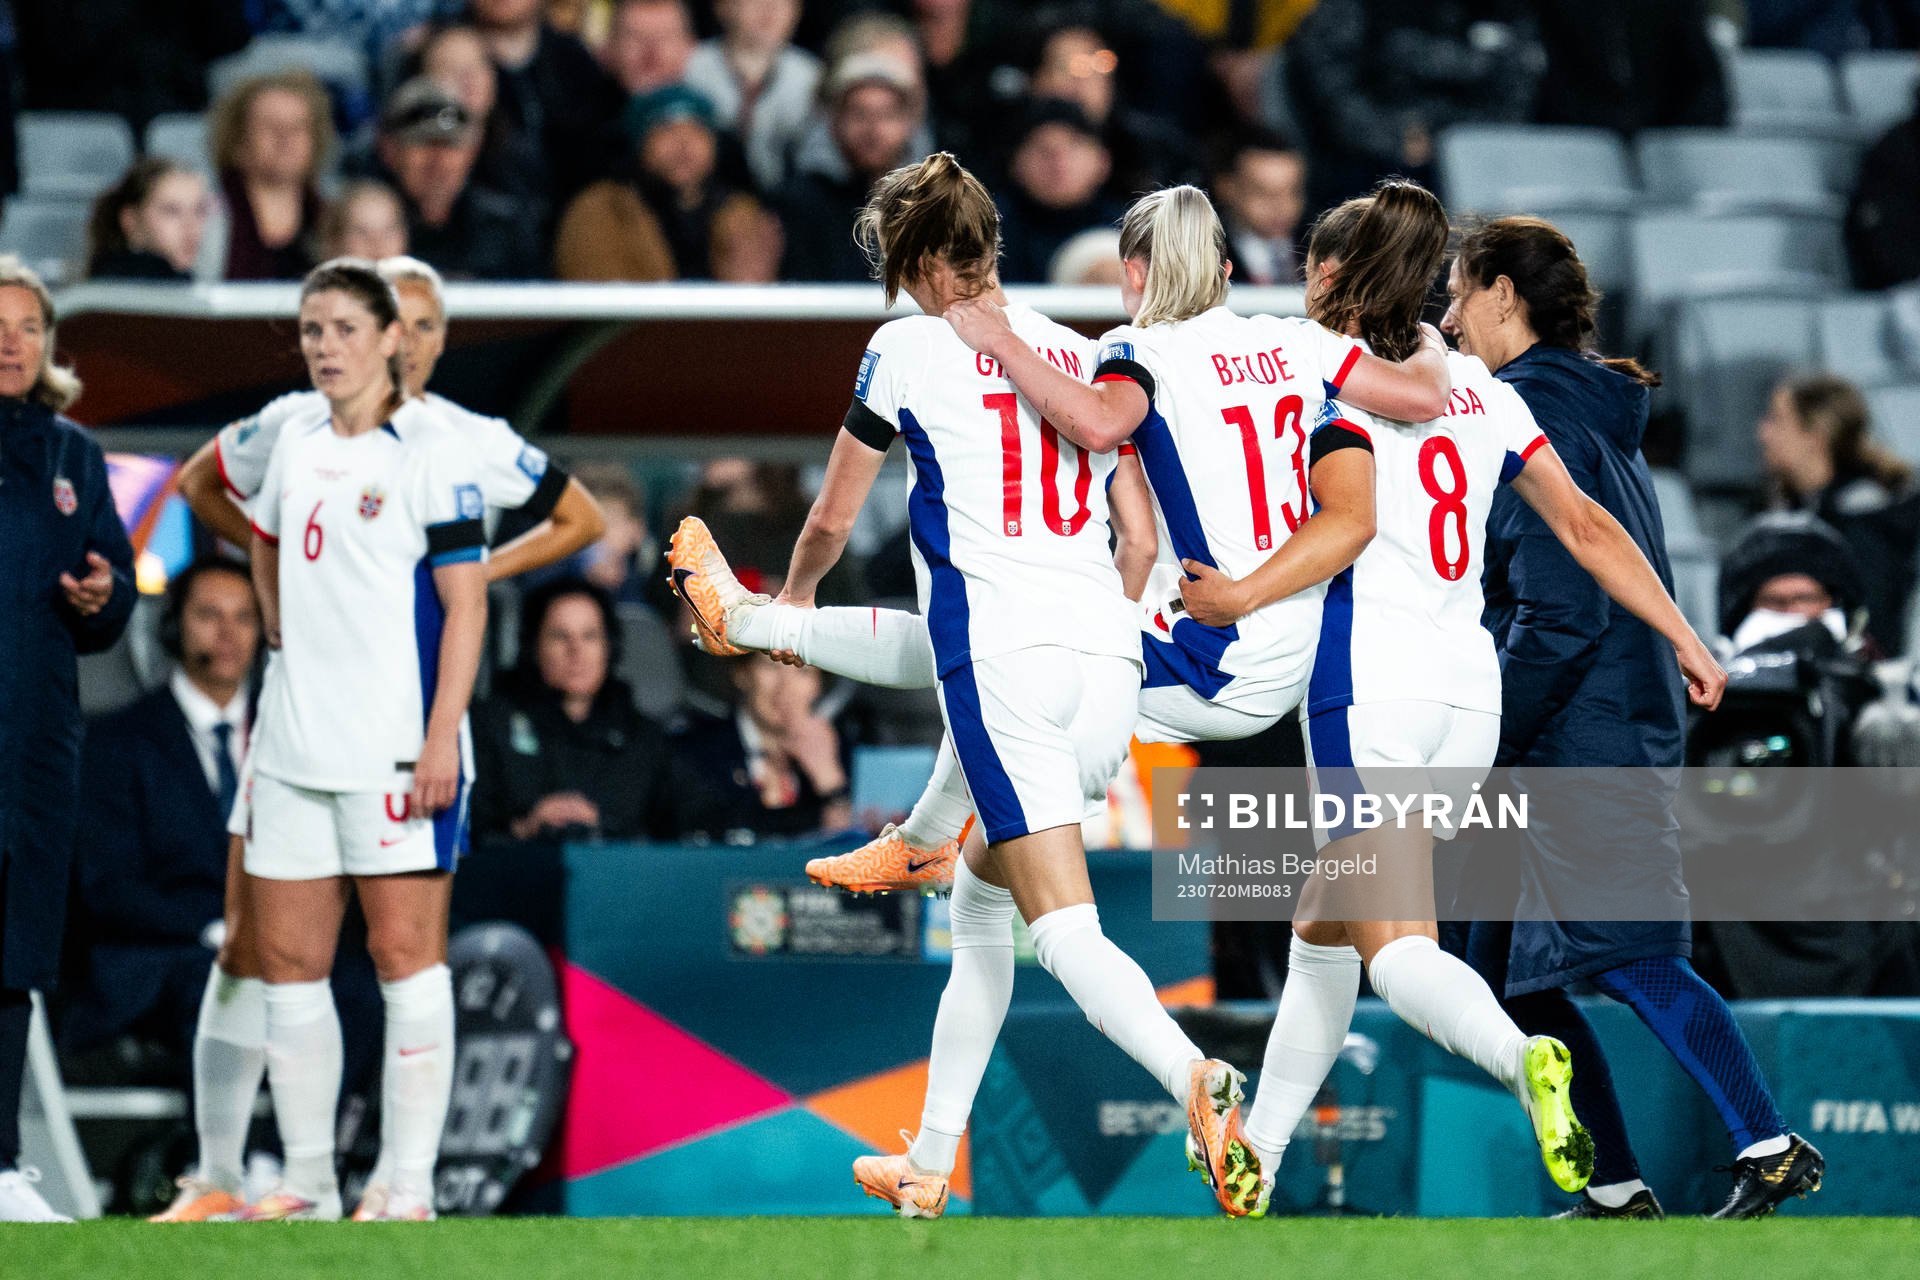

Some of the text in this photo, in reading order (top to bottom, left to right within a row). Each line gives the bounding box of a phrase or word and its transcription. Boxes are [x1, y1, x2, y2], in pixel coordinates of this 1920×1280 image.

[1442, 387, 1486, 417] ISA
[983, 393, 1093, 537] 10
[1220, 394, 1310, 552] 13
[1418, 435, 1470, 582] 8
[304, 499, 324, 562] 6
[1812, 1100, 1888, 1133] FIFA
